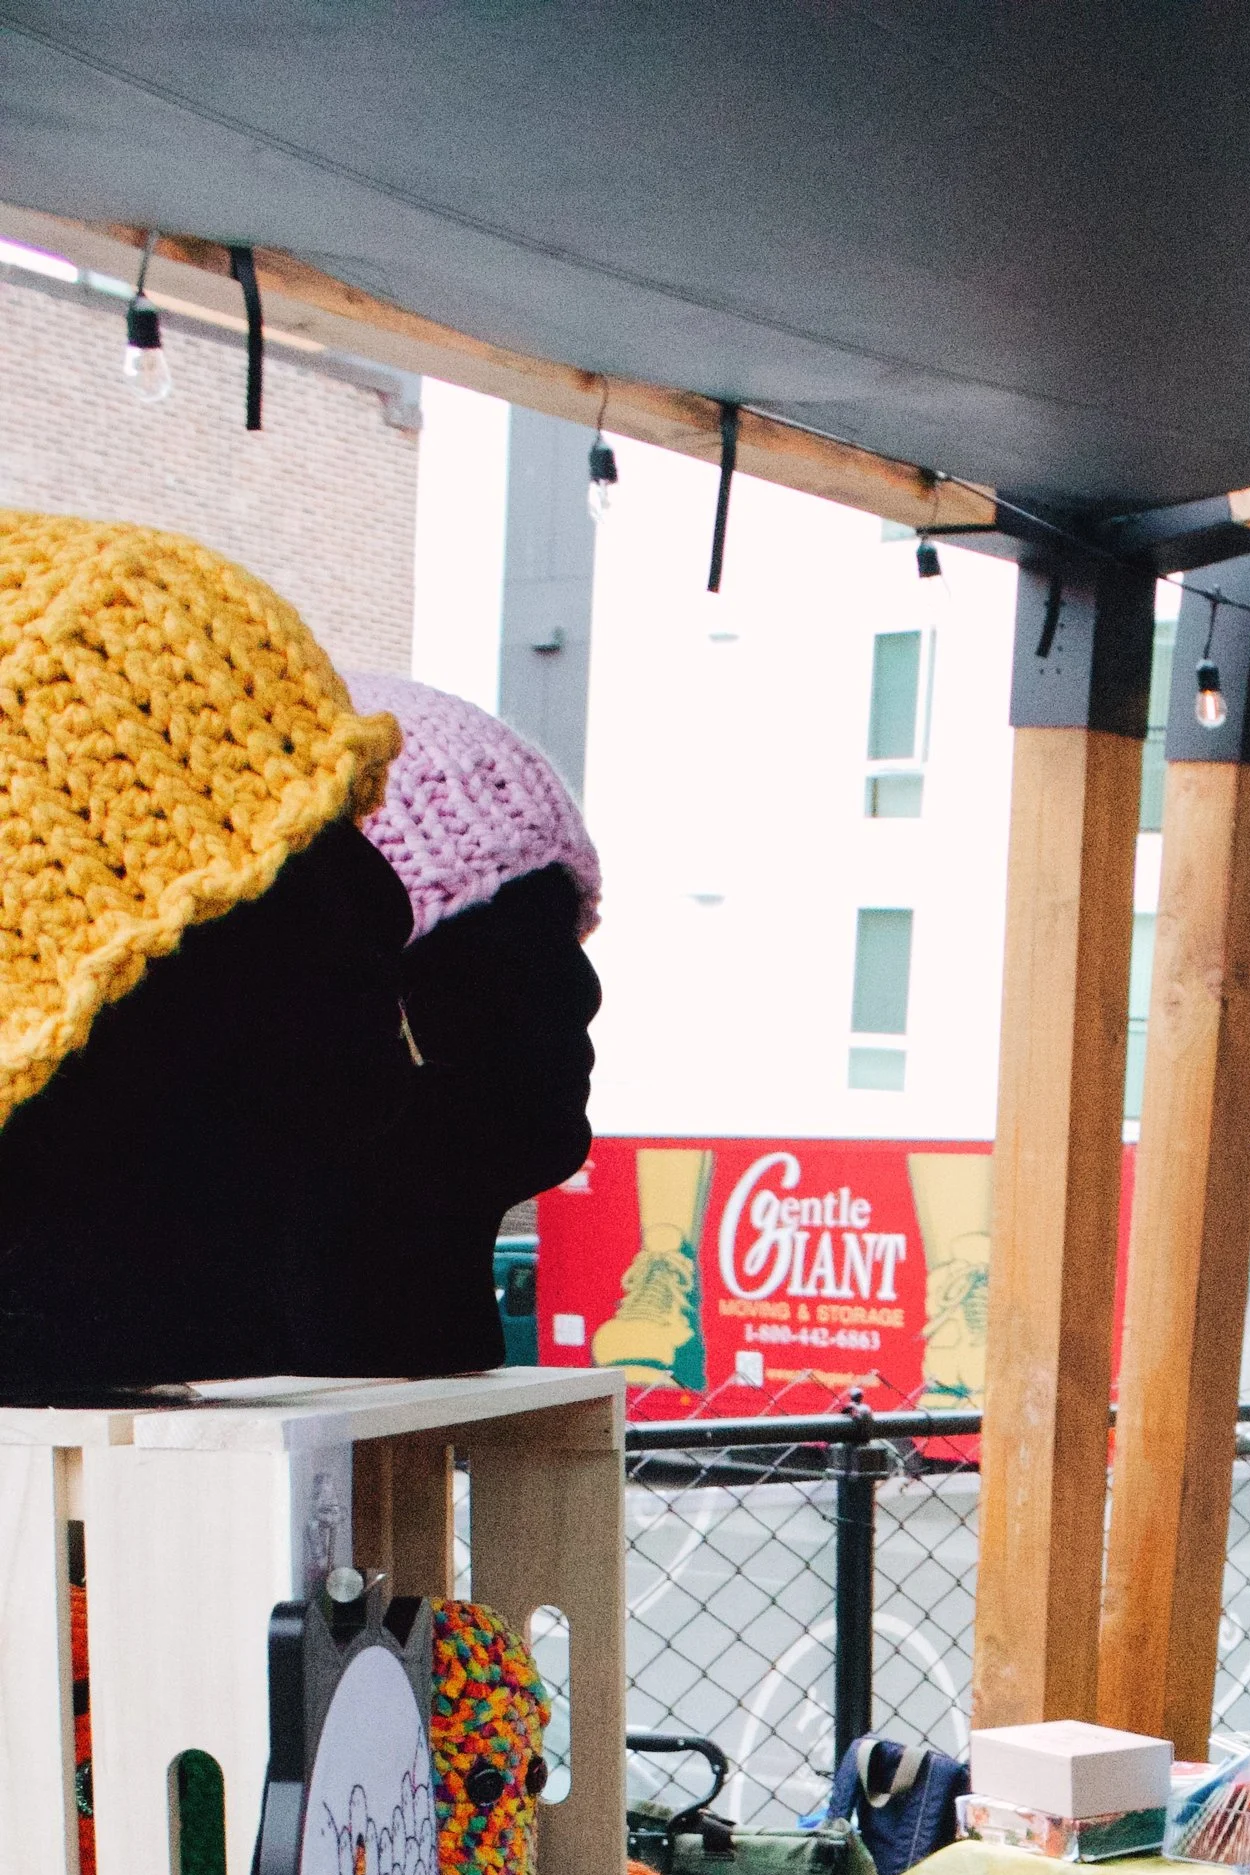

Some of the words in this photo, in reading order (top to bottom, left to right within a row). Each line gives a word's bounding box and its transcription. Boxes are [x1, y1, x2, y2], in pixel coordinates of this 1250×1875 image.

[718, 1299, 792, 1321] MOVING
[797, 1303, 811, 1322] &
[816, 1304, 905, 1329] STORAGE
